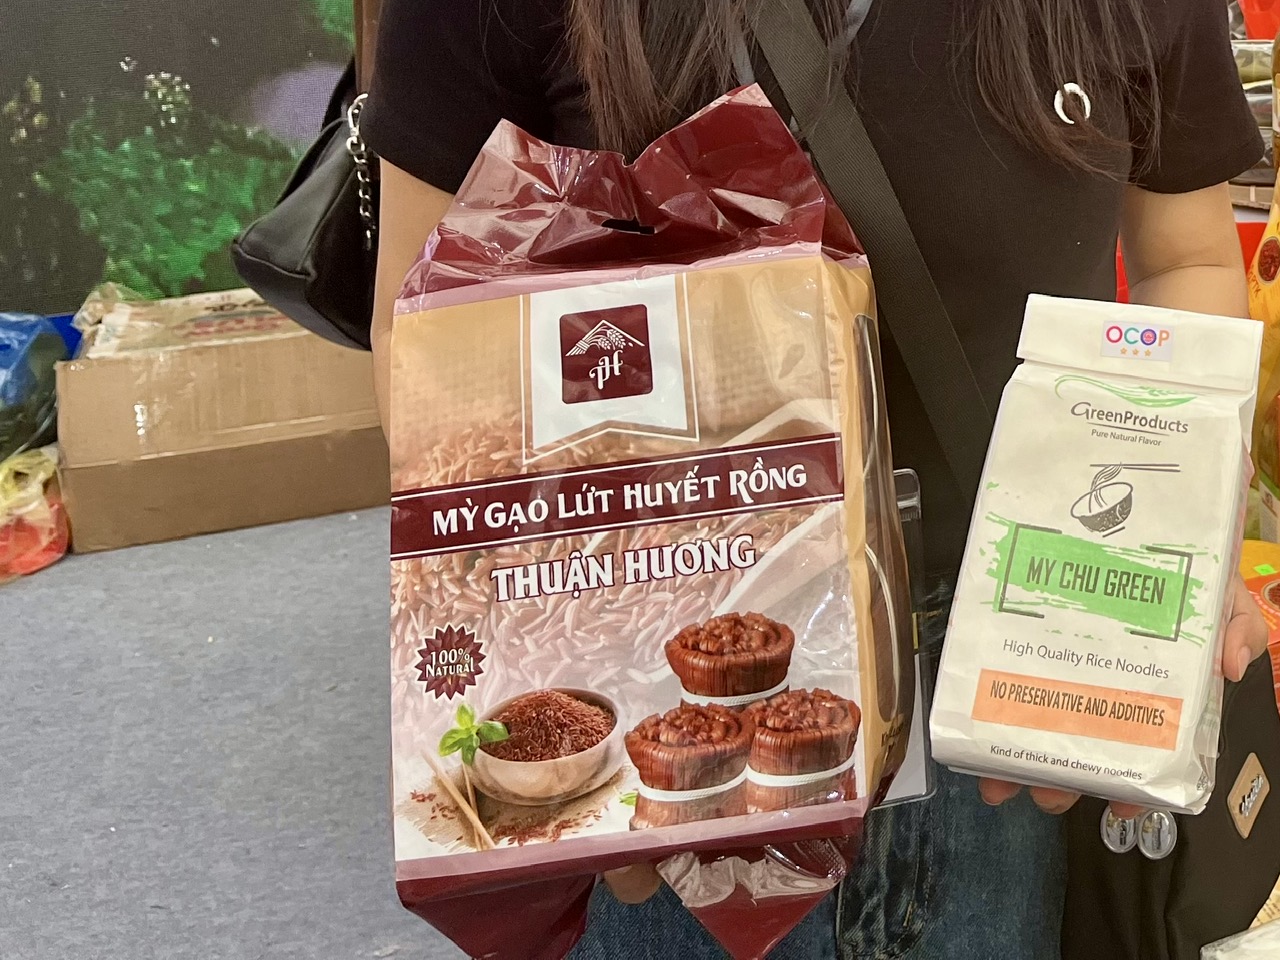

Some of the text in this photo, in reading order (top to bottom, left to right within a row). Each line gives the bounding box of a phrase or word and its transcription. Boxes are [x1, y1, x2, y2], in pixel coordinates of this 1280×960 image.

[1106, 326, 1170, 346] OCOP
[1070, 402, 1188, 434] GreenProducts
[1091, 429, 1161, 446] Pure Natural Flavor
[432, 456, 807, 537] MỲ GẠO LỨT HUYẾT RỒNG
[491, 534, 756, 602] THUẬN HƯƠNG
[1026, 556, 1166, 605] MY CHU GREEN
[430, 648, 470, 665] 100%
[1003, 638, 1169, 680] High Quality Rice Noodles
[990, 680, 1165, 727] NO PRESERVATIVE AND ADDITIVES
[990, 745, 1142, 780] Kind of thick and chewy noodles
